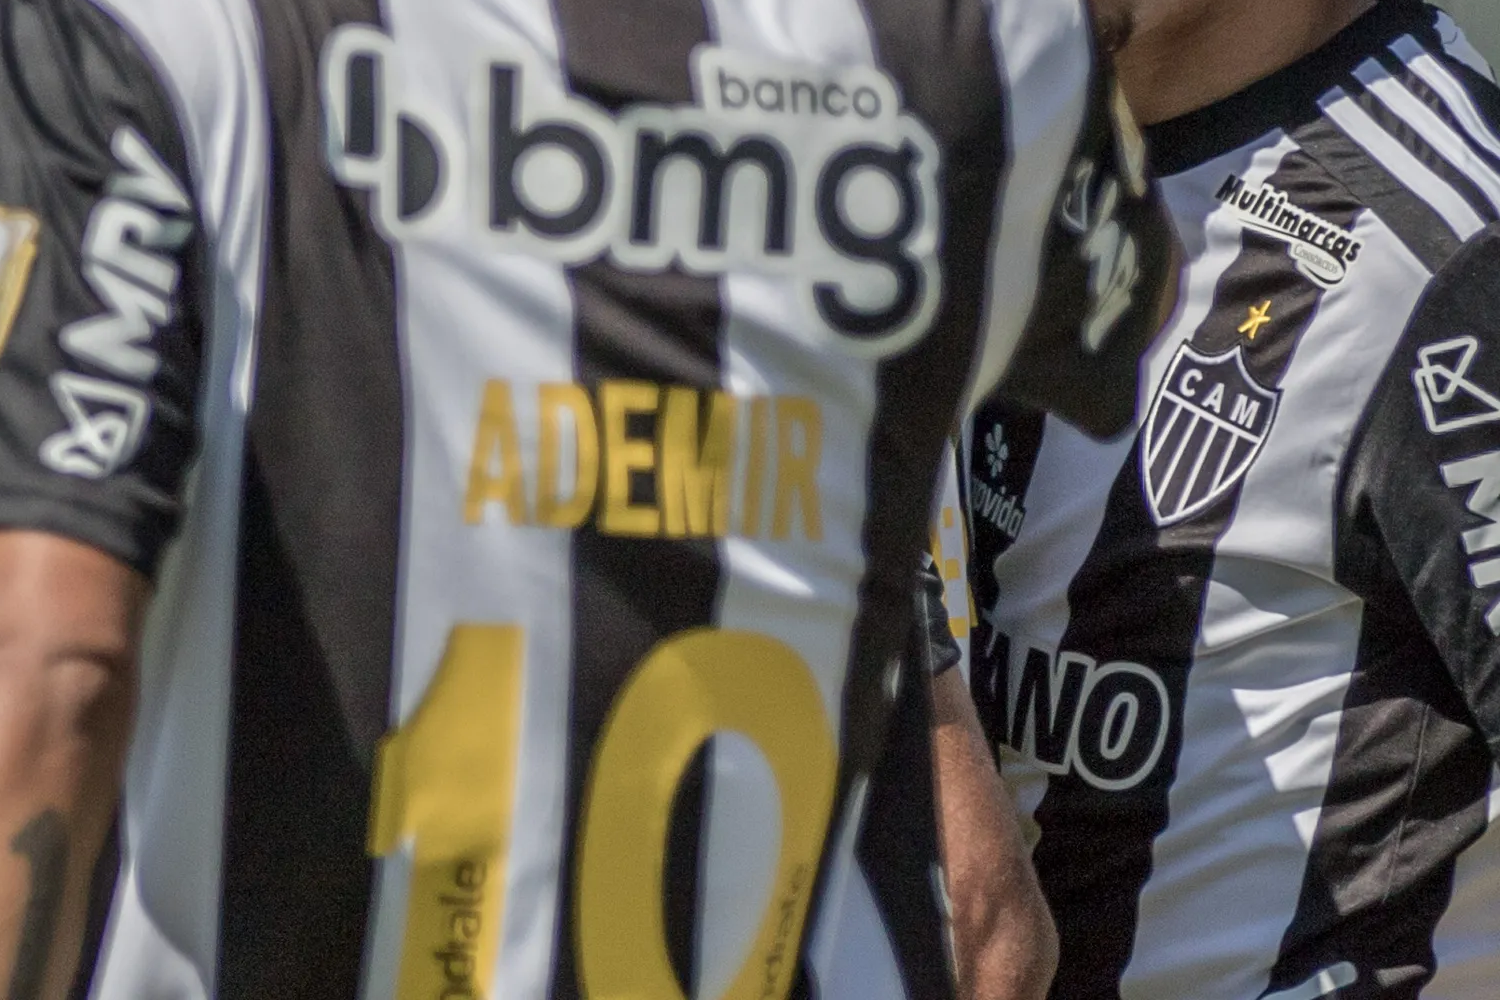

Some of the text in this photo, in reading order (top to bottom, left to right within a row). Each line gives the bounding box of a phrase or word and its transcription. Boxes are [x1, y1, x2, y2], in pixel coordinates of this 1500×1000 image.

[717, 67, 882, 120] banco
[488, 62, 926, 341] bmg
[1214, 173, 1362, 262] Multimarcas
[463, 377, 825, 541] ADEMIR
[1180, 368, 1260, 429] CAM
[368, 623, 839, 1000] 10
